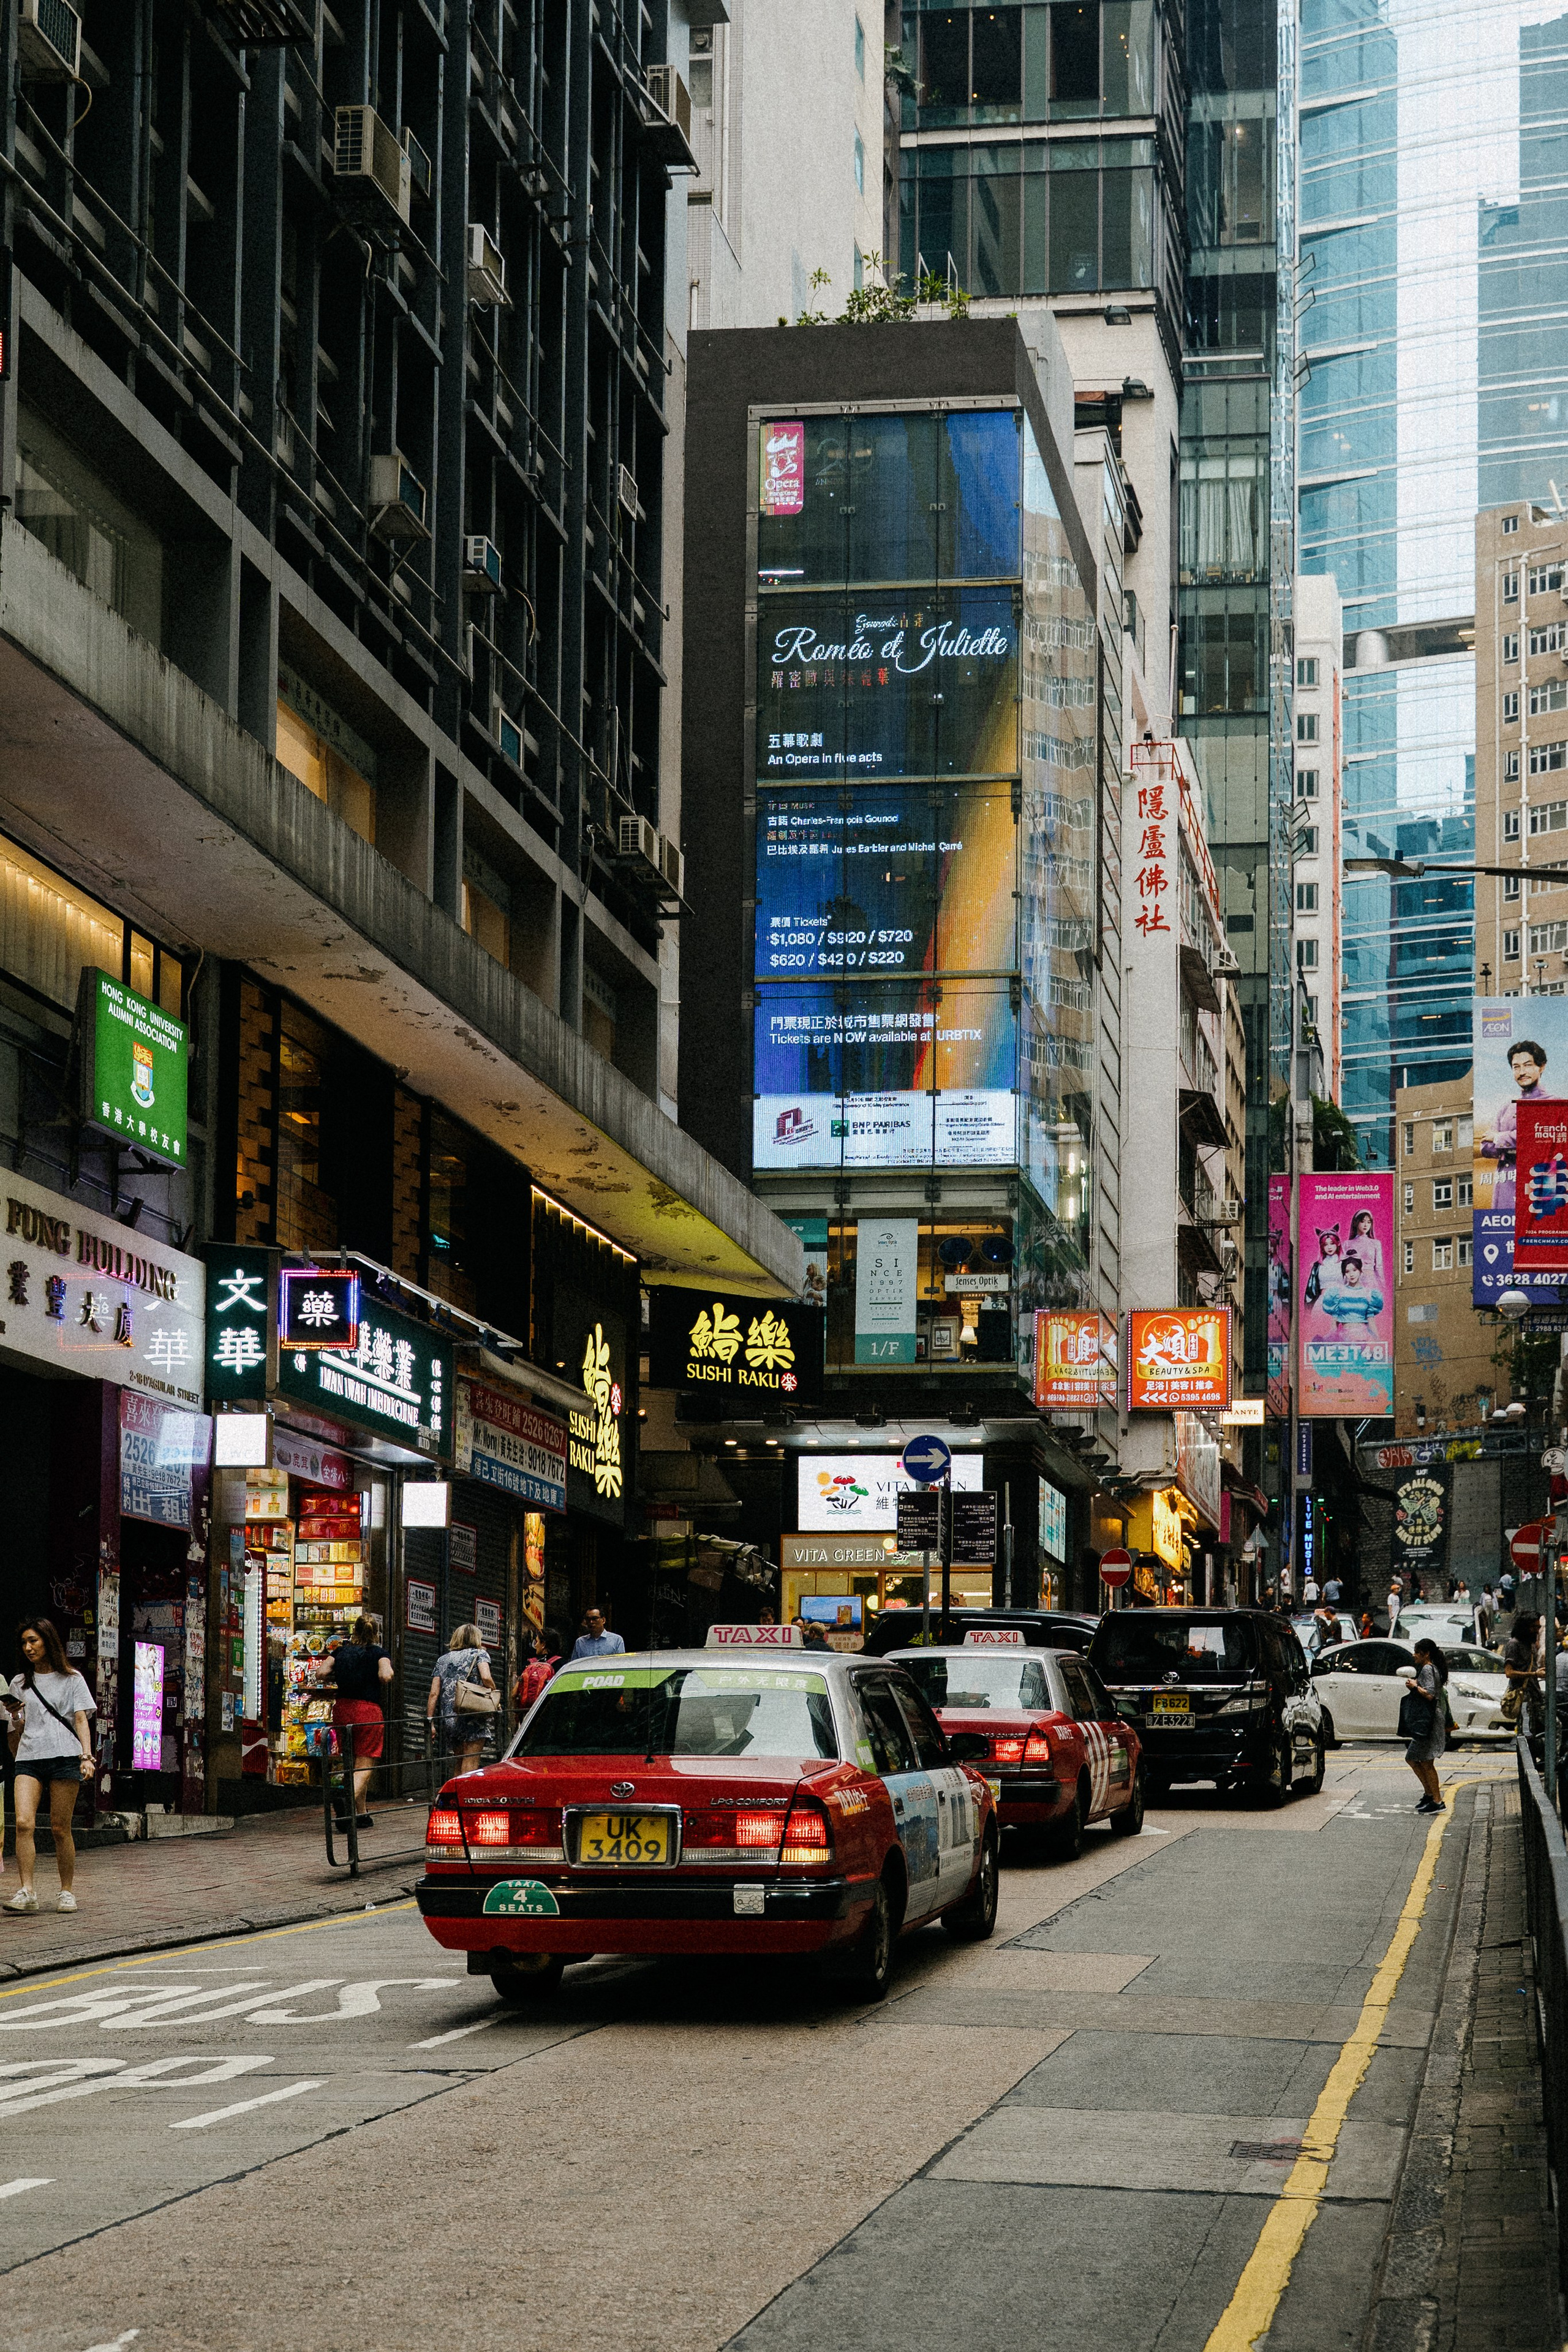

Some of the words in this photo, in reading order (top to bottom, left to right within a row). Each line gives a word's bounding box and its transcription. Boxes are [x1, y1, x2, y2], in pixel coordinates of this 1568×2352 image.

[766, 478, 800, 492] Opera
[772, 627, 873, 663] Roméo
[881, 631, 904, 658] et
[895, 620, 1008, 674] Juliette
[768, 733, 823, 748] 五幕歌劇
[768, 754, 783, 765] An
[785, 753, 820, 766] Opera
[823, 753, 832, 763] in
[859, 752, 883, 762] acts
[865, 814, 899, 824] Gounod
[832, 845, 857, 854] Jues
[890, 843, 906, 853] and
[1134, 785, 1170, 938] 隱廬佛社
[770, 933, 815, 947] $1,080
[878, 930, 913, 943] $720
[770, 954, 805, 967] $620
[818, 953, 856, 966] $420
[869, 951, 905, 964] $220
[102, 981, 123, 1004] HONG
[126, 996, 147, 1019] KONG
[150, 1012, 183, 1041] UNIVERSITY
[108, 1002, 134, 1027] ALUMNI
[135, 1018, 177, 1054] ASSOCIATION
[770, 1033, 810, 1044] Tickets
[813, 1034, 831, 1043] are
[834, 1032, 866, 1043] NOW
[869, 1031, 917, 1042] available
[920, 1032, 931, 1041] at
[937, 1029, 981, 1041] URBTIX
[102, 1101, 180, 1156] 香港大學校友會
[1534, 1122, 1567, 1132] french
[1535, 1132, 1555, 1144] may
[6, 1197, 71, 1256] FUNG
[77, 1229, 179, 1302] BUILDING
[956, 1276, 976, 1286] Senses
[979, 1276, 998, 1286] Optik
[1496, 1274, 1530, 1286] 3628
[1534, 1273, 1568, 1284] 4027
[298, 1290, 339, 1327] 藥
[213, 1268, 268, 1374] 文華
[688, 1302, 795, 1370] 鮨樂
[1136, 1325, 1191, 1366] 大順
[339, 1321, 416, 1390] 華藥業
[871, 1341, 899, 1356] 1/F
[687, 1363, 732, 1384] SUSHI
[738, 1370, 779, 1389] RAKU
[1145, 1381, 1164, 1391] 足浴
[1170, 1381, 1189, 1390] 美容
[177, 1387, 199, 1404] STREET
[368, 1387, 419, 1428] MEDICINE
[522, 1411, 543, 1440] 2526
[545, 1422, 564, 1450] 0267
[569, 1411, 596, 1444] SUSHI
[124, 1432, 156, 1466] 2526
[570, 1440, 595, 1474] RAKU
[293, 1452, 309, 1470] 鹿茸
[528, 1446, 545, 1475] 9018
[547, 1455, 565, 1483] 7672
[167, 1473, 181, 1487] 7672
[876, 1481, 911, 1492] VITA
[1412, 1478, 1425, 1490] ALL
[132, 1489, 183, 1524] 出租
[1414, 1536, 1422, 1546] IT
[1423, 1523, 1442, 1544] SLOW
[793, 1548, 827, 1562] VITA
[833, 1548, 885, 1561] GREEN
[1304, 1534, 1313, 1575] MUSIC
[714, 1627, 792, 1643] TAXI
[970, 1632, 1018, 1643] TAXI
[582, 1675, 625, 1689] POAD
[607, 1817, 642, 1840] UK
[587, 1839, 661, 1862] 3409
[513, 1890, 527, 1903] 4
[0, 1978, 462, 2030] BUS
